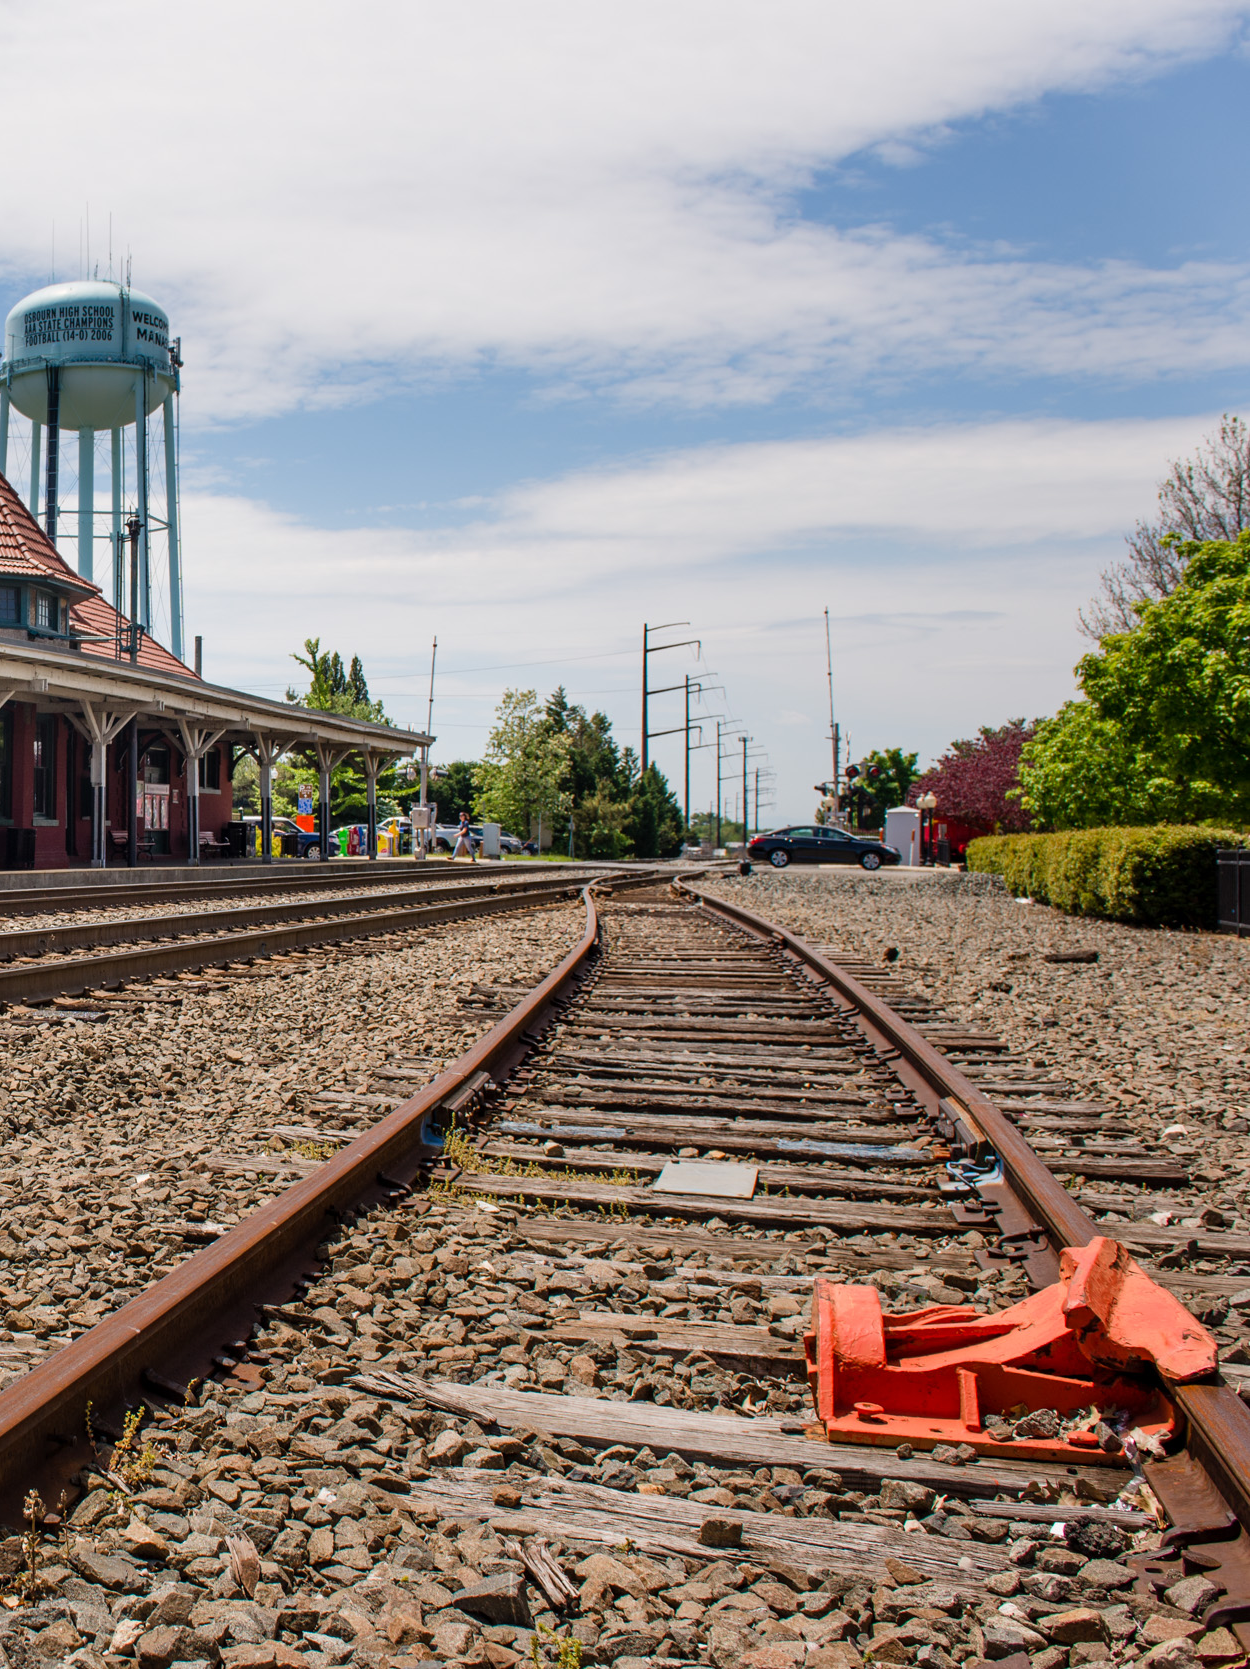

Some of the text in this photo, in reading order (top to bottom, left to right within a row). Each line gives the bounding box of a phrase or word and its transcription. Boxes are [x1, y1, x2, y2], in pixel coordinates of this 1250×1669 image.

[25, 305, 115, 324] OSBOURN HIGH SCHOOL
[24, 317, 114, 335] AAA STATE CHAMPIONS
[25, 329, 113, 348] FOOTBALL (14-0) 2006
